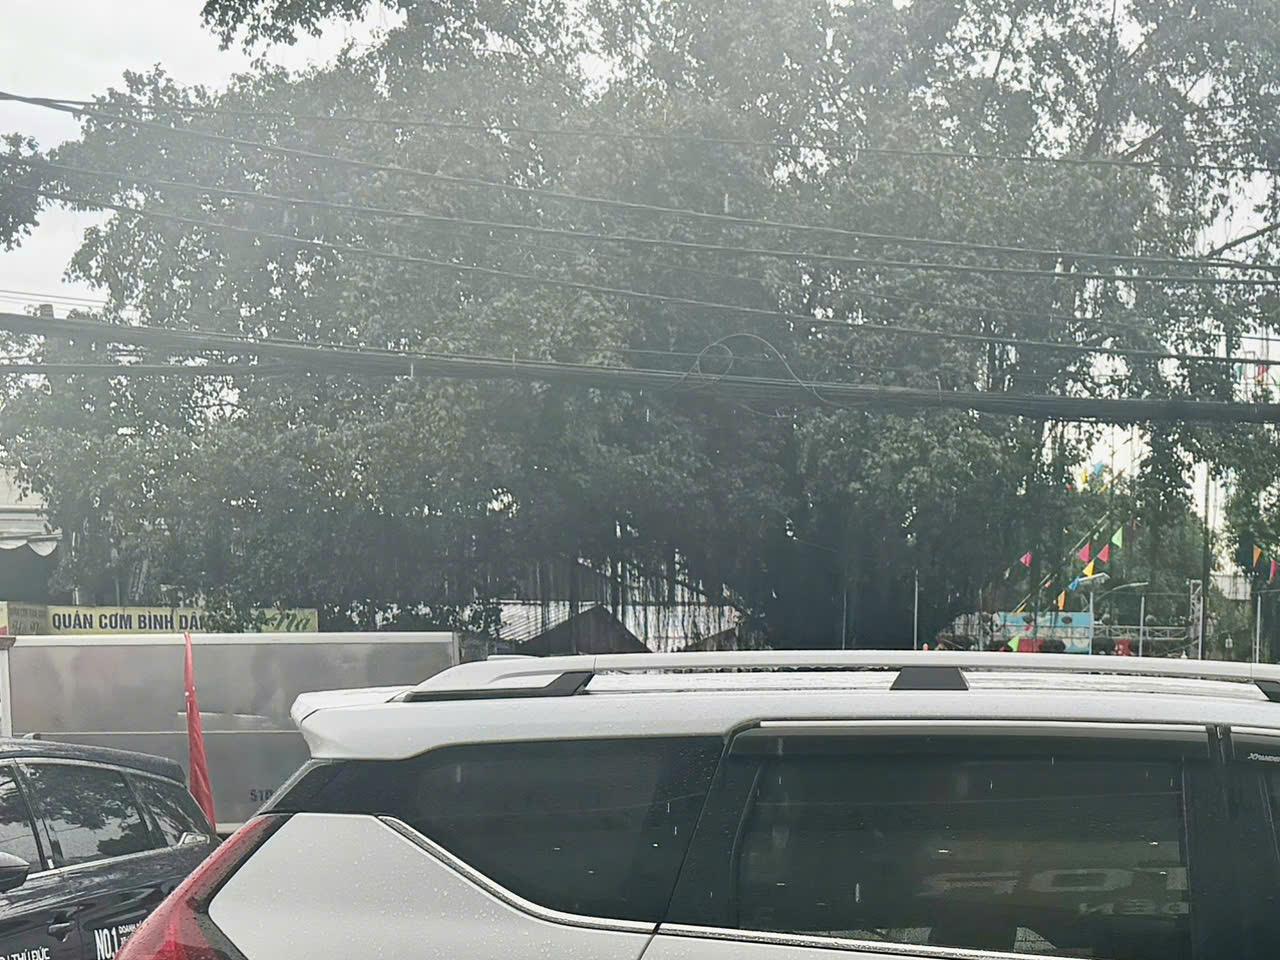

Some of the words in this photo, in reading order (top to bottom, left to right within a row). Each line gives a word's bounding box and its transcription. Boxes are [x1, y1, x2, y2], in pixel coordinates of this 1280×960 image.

[52, 610, 93, 631] QUÁN
[99, 612, 132, 630] CƠM
[138, 609, 174, 630] BÌNH
